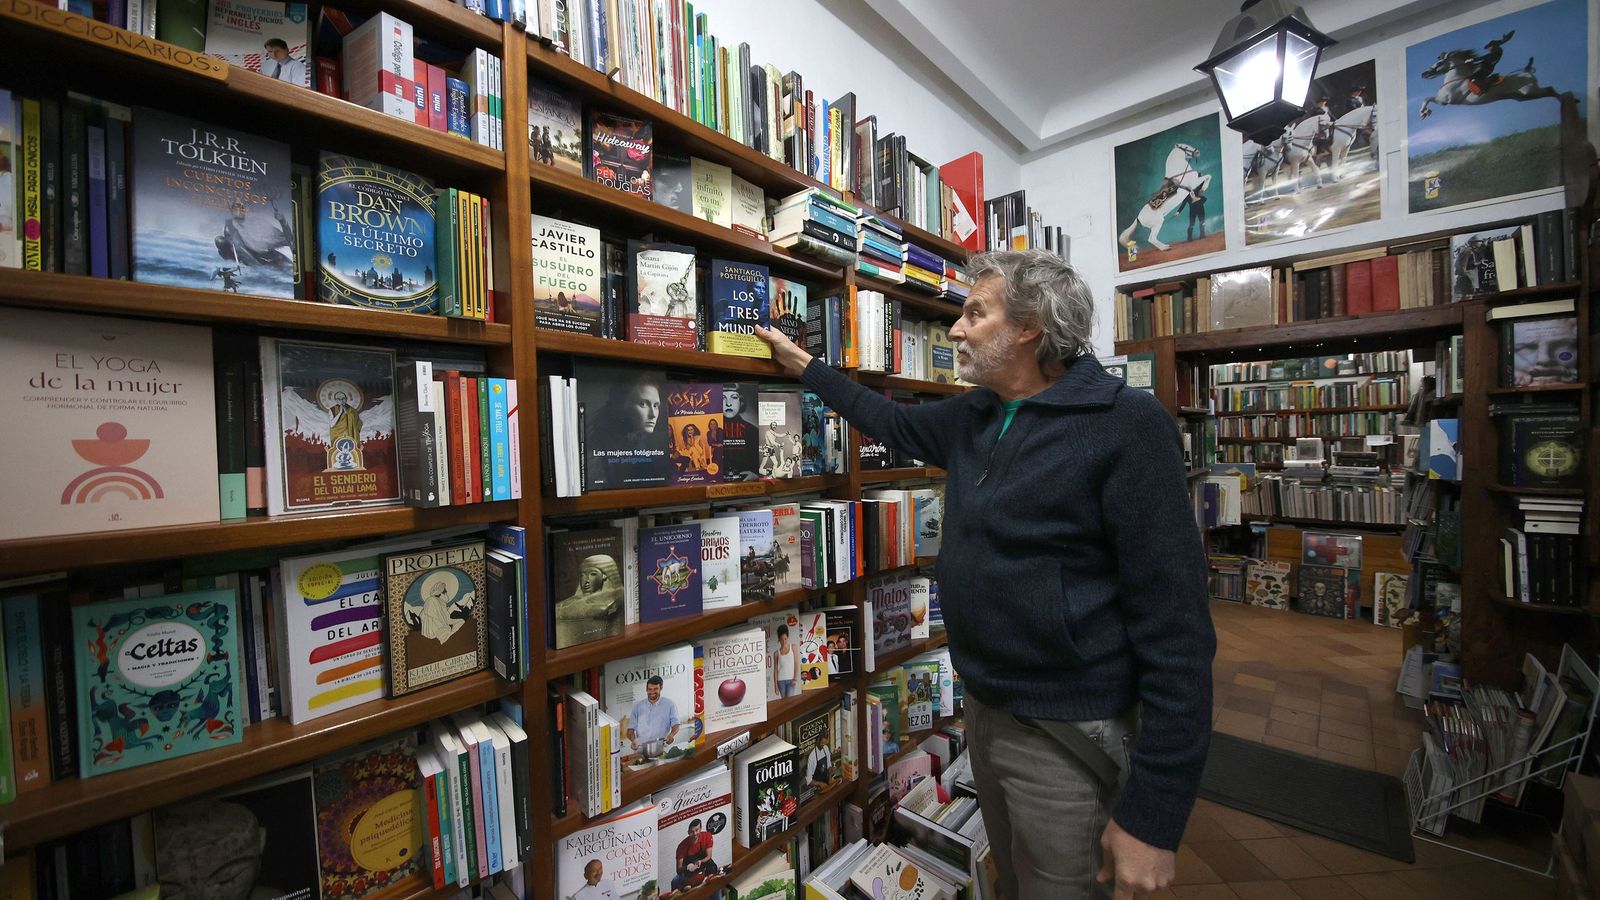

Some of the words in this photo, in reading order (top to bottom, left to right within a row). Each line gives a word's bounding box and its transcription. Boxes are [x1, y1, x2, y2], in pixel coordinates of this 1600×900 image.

[9, 2, 211, 71] DICCIONARIOS
[415, 85, 425, 107] mini
[433, 93, 442, 112] mini
[188, 128, 247, 155] J.R.R.
[594, 131, 650, 154] Hideaway
[160, 138, 269, 176] TOLKIEN
[184, 169, 252, 191] CUENTOS
[596, 177, 651, 196] DOUGLAS
[357, 191, 404, 215] DAN
[328, 200, 426, 237] BROWN
[335, 223, 357, 236] EL
[362, 224, 424, 249] ÚLTIMO
[539, 228, 587, 246] JAVIER
[343, 235, 418, 258] SECRETO
[531, 237, 595, 259] CASTILLO
[531, 258, 594, 277] SUSURRO
[724, 266, 762, 277] SANTIAGO
[539, 275, 588, 292] FUEGO
[733, 290, 755, 302] LOS
[728, 306, 760, 320] TRES
[718, 322, 769, 335] MUND
[55, 353, 84, 370] EL
[91, 356, 162, 374] YOGA
[29, 371, 63, 390] de
[75, 373, 96, 391] la
[107, 377, 183, 396] mujer
[607, 450, 633, 458] mujeres
[633, 449, 665, 458] fotógrafas
[314, 475, 327, 487] EL
[330, 473, 377, 486] SENDERO
[314, 487, 330, 496] DEL
[356, 483, 377, 493] LAMA
[659, 532, 693, 542] UNICORNIO
[701, 536, 730, 549] ORIMOS
[391, 547, 481, 574] PROFETA
[701, 546, 730, 561] OLOS
[355, 570, 379, 580] JULIA
[339, 597, 354, 609] EL
[327, 625, 353, 641] DEL
[125, 637, 198, 661] Celtas
[708, 641, 764, 659] RESCATE
[713, 652, 764, 671] HÍGADO
[755, 759, 793, 785] cocina
[673, 789, 712, 813] guisos
[565, 826, 616, 850] KARLOS
[574, 826, 653, 860] ARGUIÑANO
[605, 839, 652, 861] COCINA
[624, 850, 652, 867] PARA
[610, 863, 653, 882] TODOS
